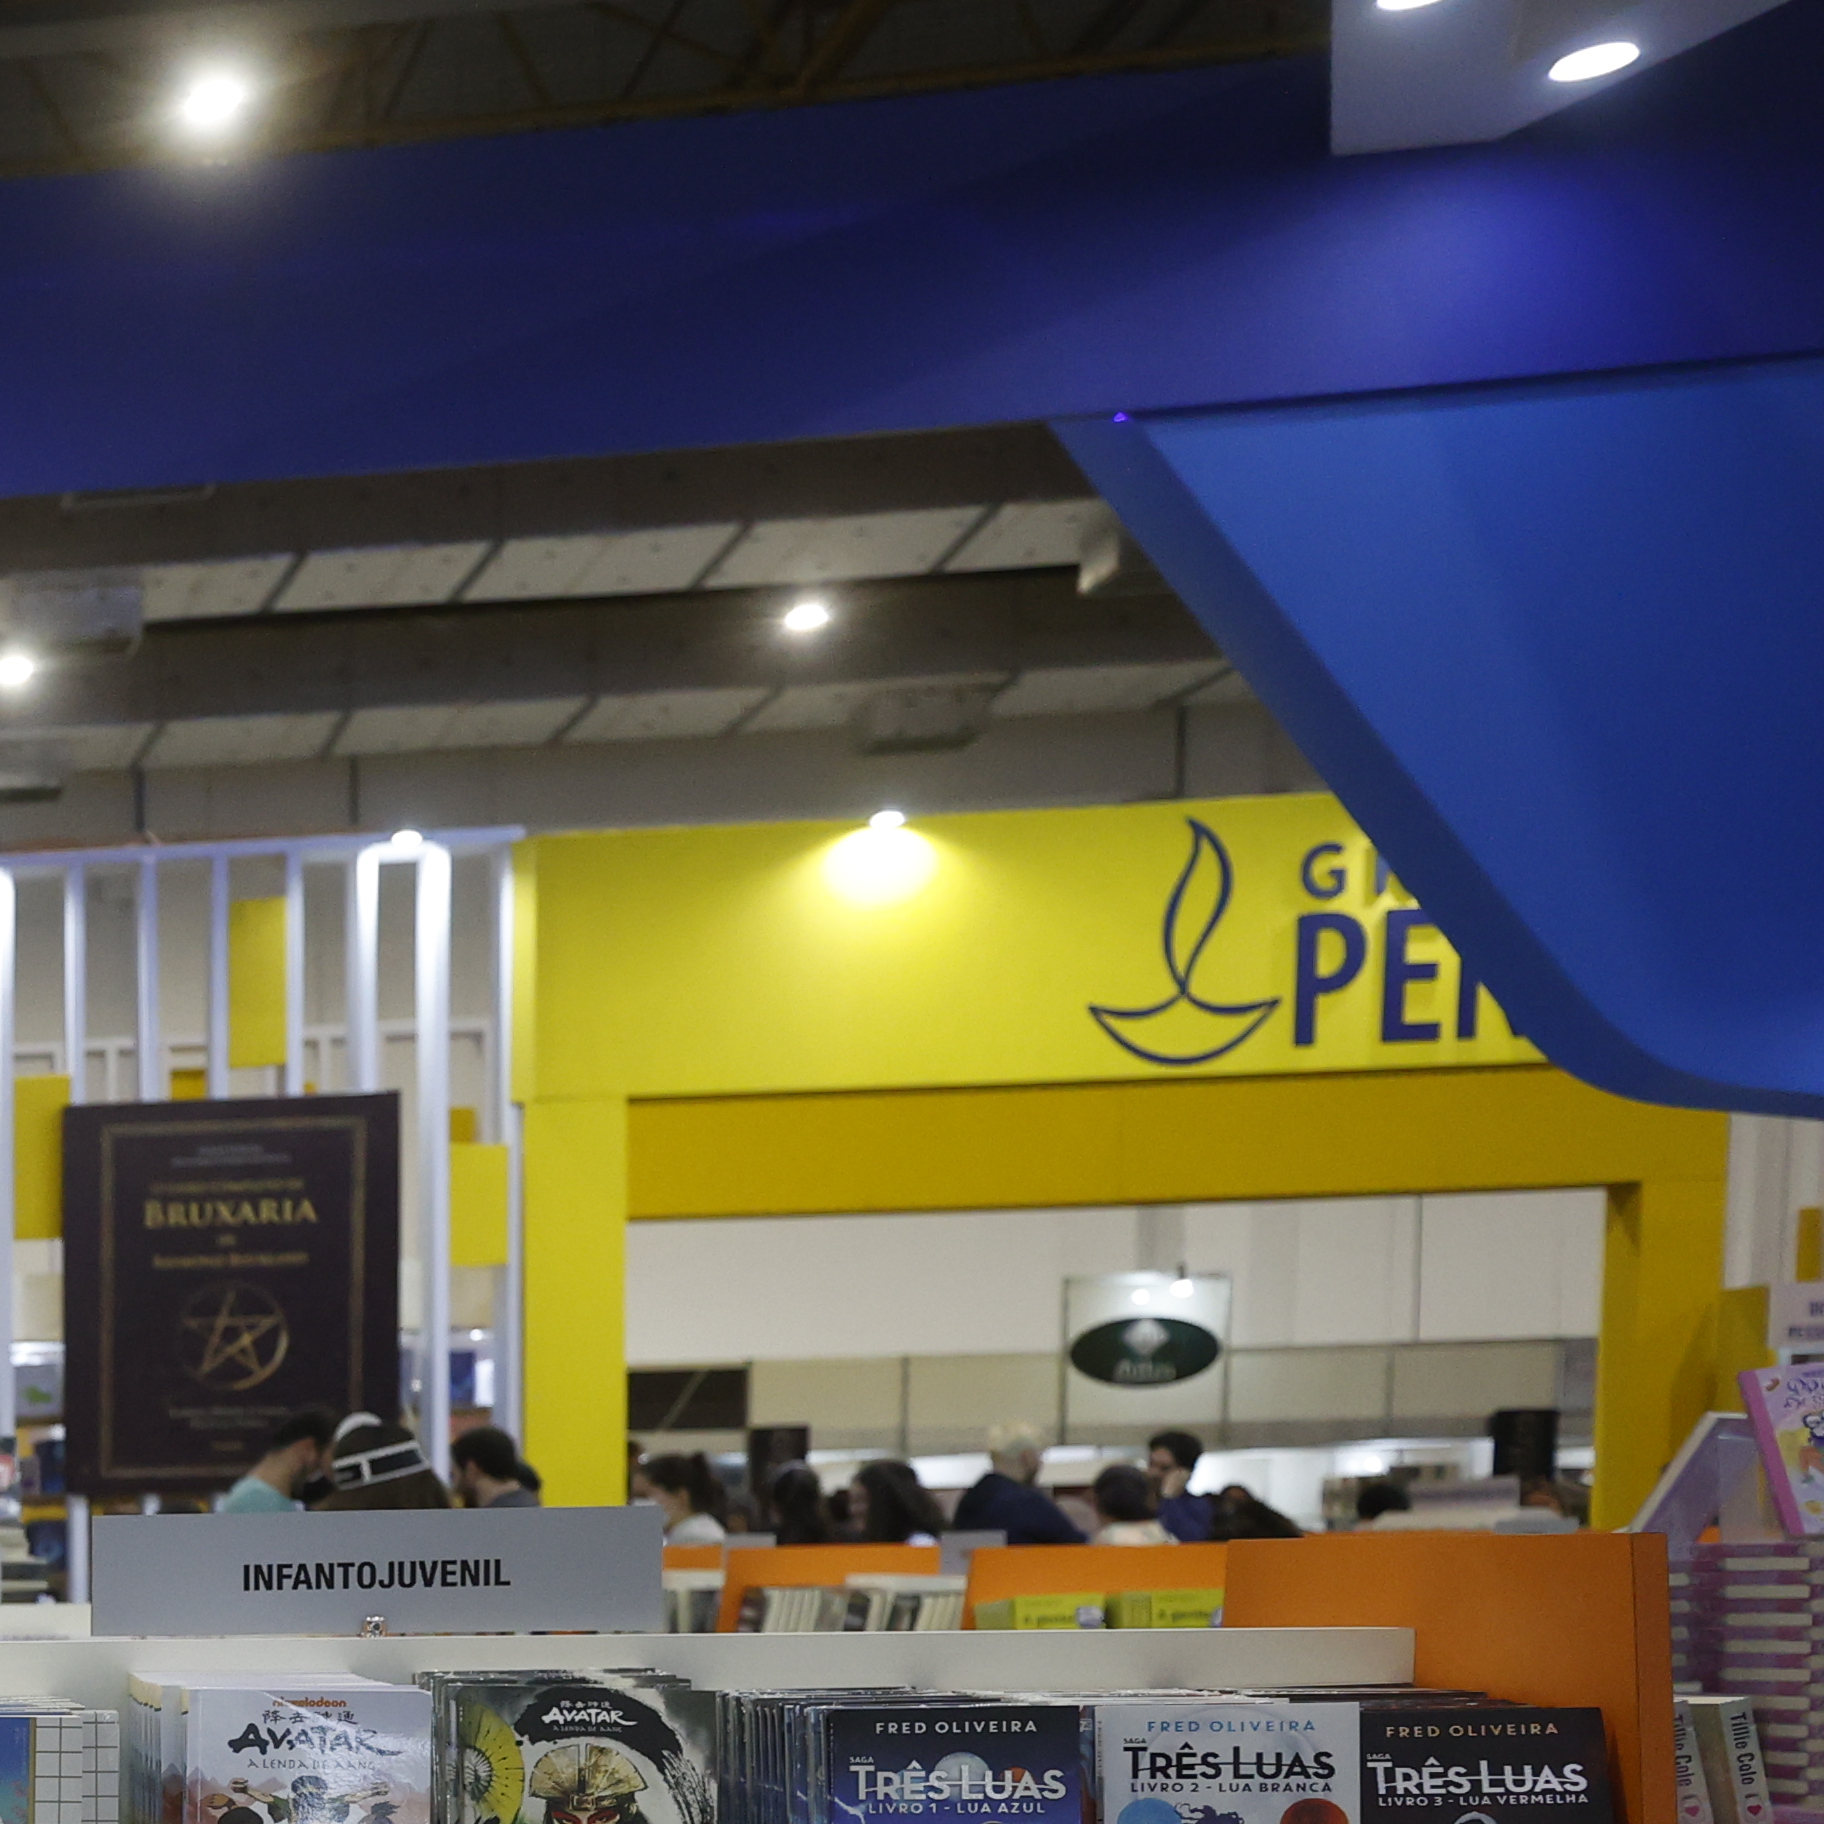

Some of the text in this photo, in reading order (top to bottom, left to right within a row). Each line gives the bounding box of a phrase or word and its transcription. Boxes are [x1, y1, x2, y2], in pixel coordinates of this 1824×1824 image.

[144, 1197, 319, 1230] BRUXARIA
[242, 1557, 512, 1593] INFANTOJUVENIL
[541, 1708, 638, 1727] AVATAR
[875, 1719, 1038, 1735] FRED OLIVEIRA
[1147, 1719, 1316, 1733] FRED OLIVEIRA
[227, 1722, 404, 1756] AVATAR
[1122, 1741, 1336, 1781] TRÊS LUAS
[848, 1759, 1067, 1801] TRÊS LUAS
[1130, 1782, 1185, 1794] LIVRO
[1189, 1782, 1200, 1793] 2
[1218, 1782, 1252, 1793] LUA
[1259, 1781, 1333, 1794] BRANCA
[868, 1802, 924, 1815] LIVRO
[928, 1802, 938, 1814] 1
[956, 1802, 992, 1814] LUA
[997, 1802, 1046, 1815] AZUL
[1378, 1796, 1431, 1808] LIVRO
[1434, 1796, 1444, 1807] 3
[1459, 1796, 1492, 1807] LUA
[1496, 1794, 1589, 1806] VERMELHA
